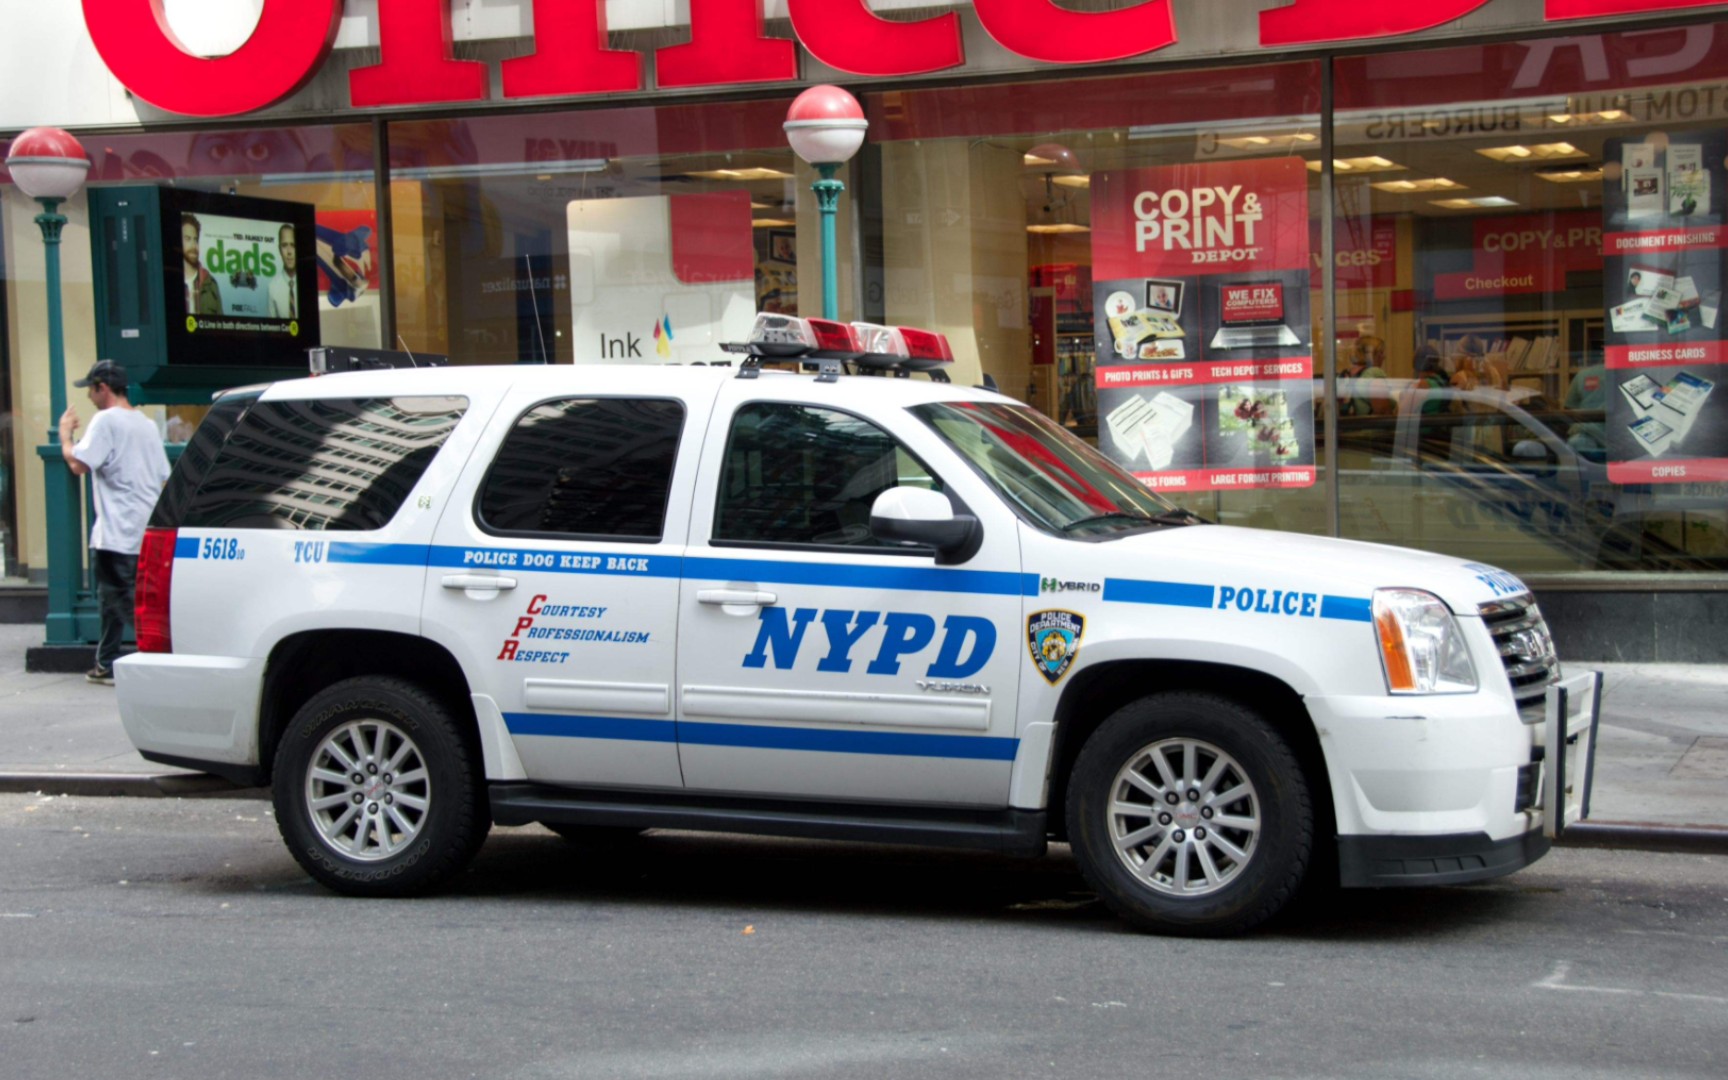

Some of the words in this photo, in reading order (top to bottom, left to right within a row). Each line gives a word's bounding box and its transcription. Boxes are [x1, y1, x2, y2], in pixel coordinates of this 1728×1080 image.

[1135, 213, 1263, 252] PRINT
[1483, 226, 1602, 253] COPY&PR
[1616, 236, 1666, 249] DOCUMENT
[1667, 231, 1715, 246] FINISHING
[206, 239, 277, 278] dads
[1191, 249, 1258, 264] DEPOT
[1464, 274, 1533, 290] Checkout
[1228, 289, 1249, 300] WE
[1253, 288, 1274, 299] FIX
[600, 331, 643, 359] Ink
[1628, 348, 1673, 362] BUSINESS
[1674, 346, 1706, 360] CARDS
[1105, 371, 1131, 382] PHOTO
[1132, 369, 1161, 381] PRINTS
[1162, 369, 1168, 380] &
[1170, 368, 1193, 380] GIFTS
[1211, 366, 1232, 377] TECH
[1233, 365, 1260, 377] DEPOT
[1264, 363, 1303, 375] SERVICES
[1211, 473, 1236, 486] LARGE
[1237, 472, 1270, 485] FORMAT
[1271, 471, 1310, 484] PRINTING
[1651, 465, 1686, 477] COPIES
[1159, 475, 1187, 487] FORMS
[294, 541, 324, 563] TCU
[463, 550, 517, 566] POLICE
[523, 553, 554, 567] DOG
[560, 554, 601, 569] KEEP
[607, 556, 649, 572] BACK
[1217, 586, 1318, 617] POLICE
[1041, 611, 1072, 621] POLICE
[1030, 619, 1081, 633] DEPARTMENT
[742, 606, 998, 679] NYPD
[1030, 641, 1040, 660] CITY
[300, 698, 421, 739] WRANGLER
[306, 837, 431, 883] GOODYEAR
